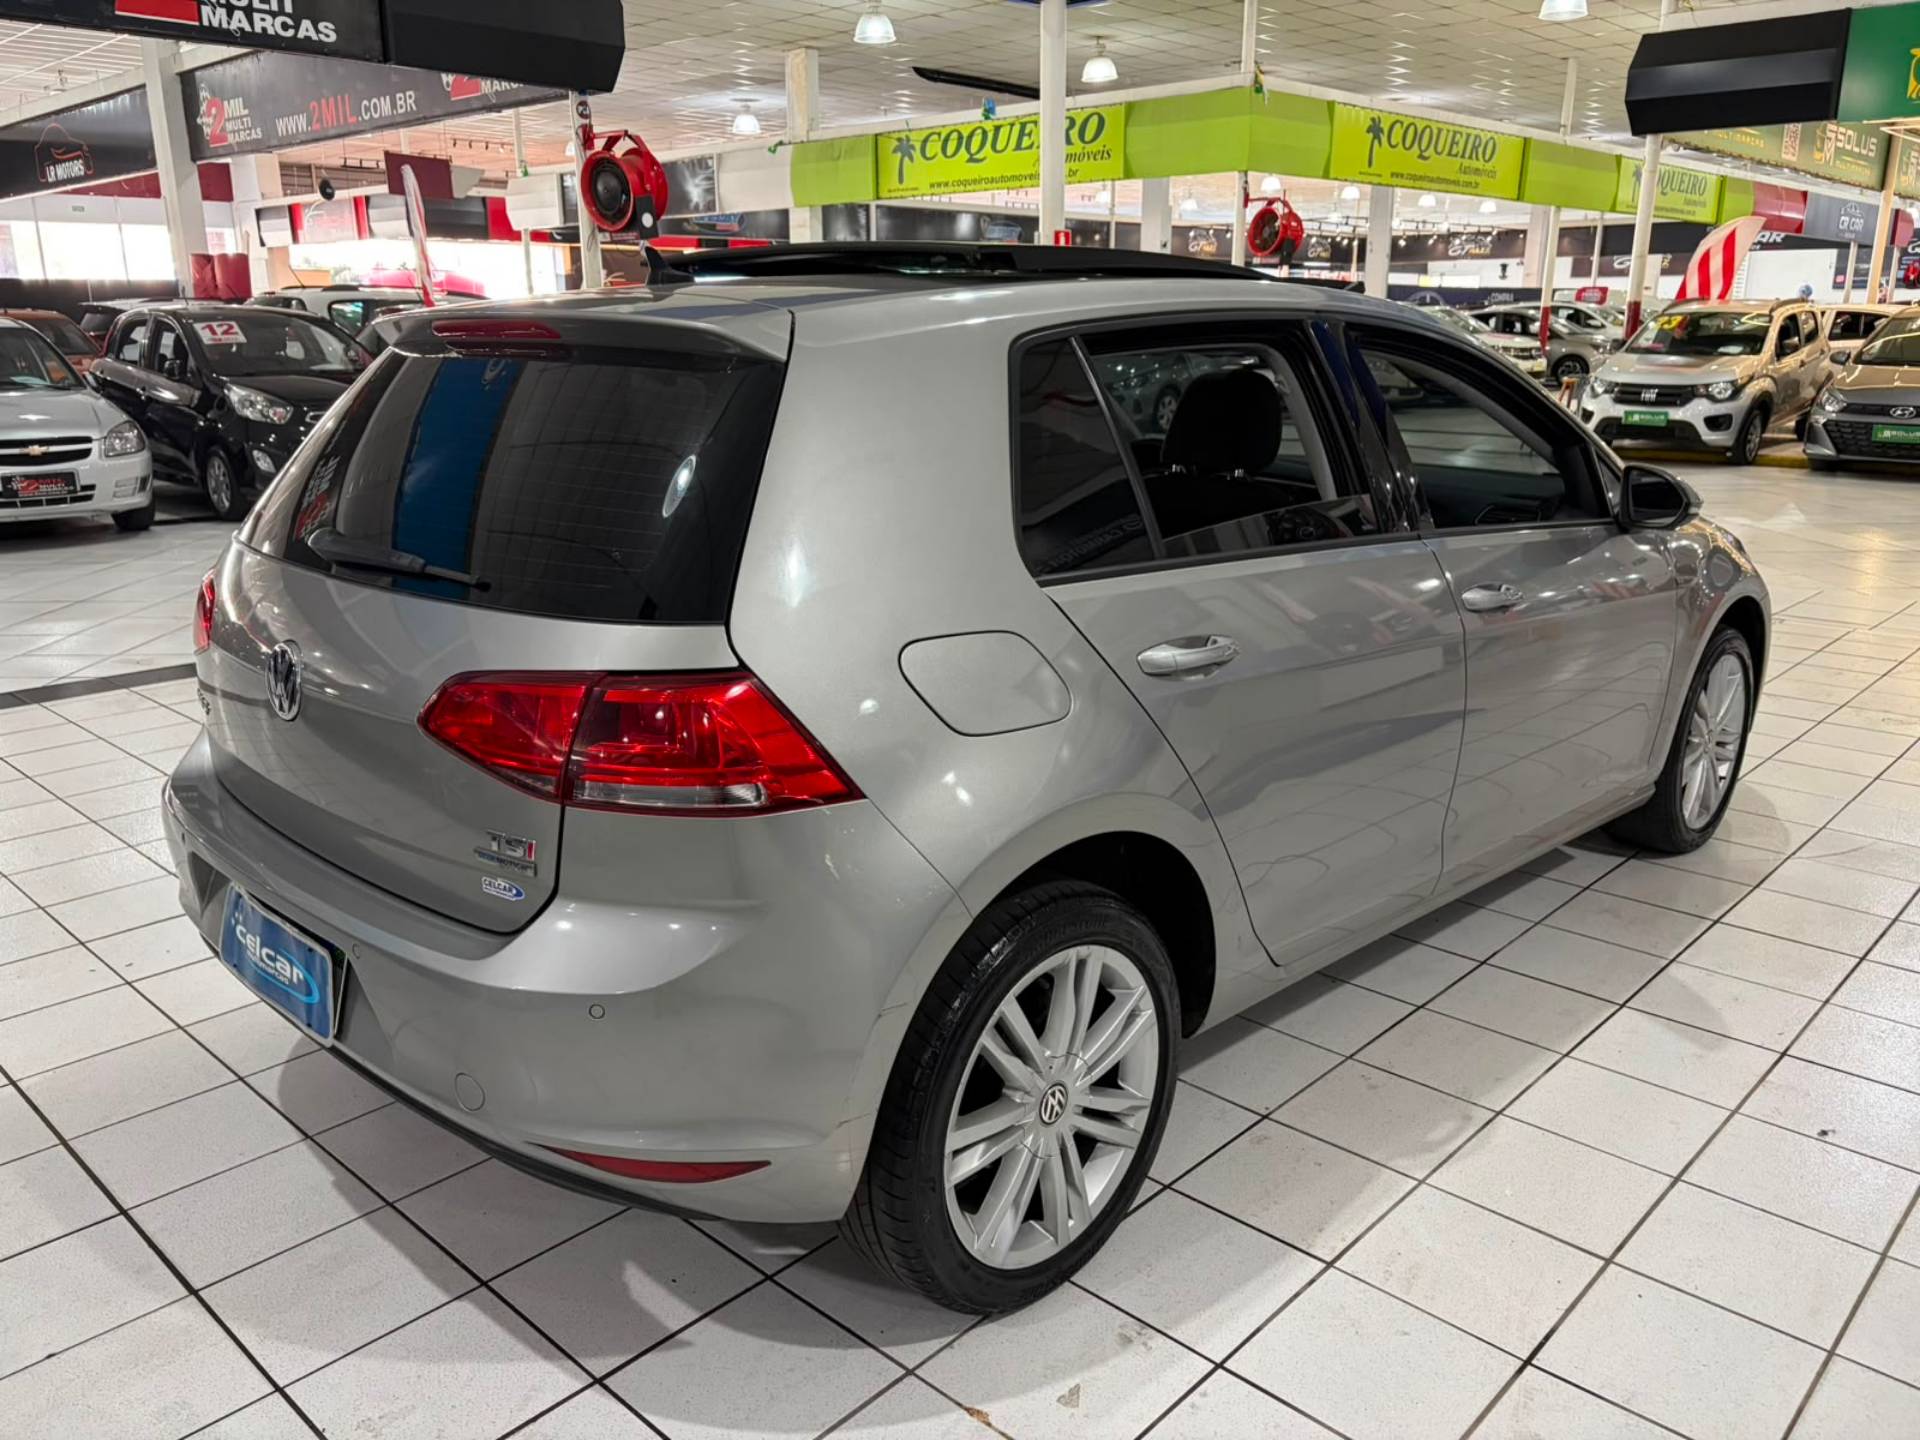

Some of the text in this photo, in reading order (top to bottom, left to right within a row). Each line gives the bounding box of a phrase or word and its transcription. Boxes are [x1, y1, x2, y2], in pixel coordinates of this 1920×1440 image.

[200, 5, 337, 42] MARCAS
[205, 97, 229, 147] 2
[223, 97, 249, 118] MIL
[225, 116, 251, 131] MULTI
[228, 128, 262, 144] MARCAS
[919, 112, 1105, 164] COQUERO
[1387, 119, 1497, 163] COQUEIRO
[1836, 126, 1878, 158] SOLUS
[46, 159, 85, 183] LR MOTORS
[201, 323, 239, 336] 12
[486, 829, 536, 861] TSI
[236, 924, 304, 984] celcar
